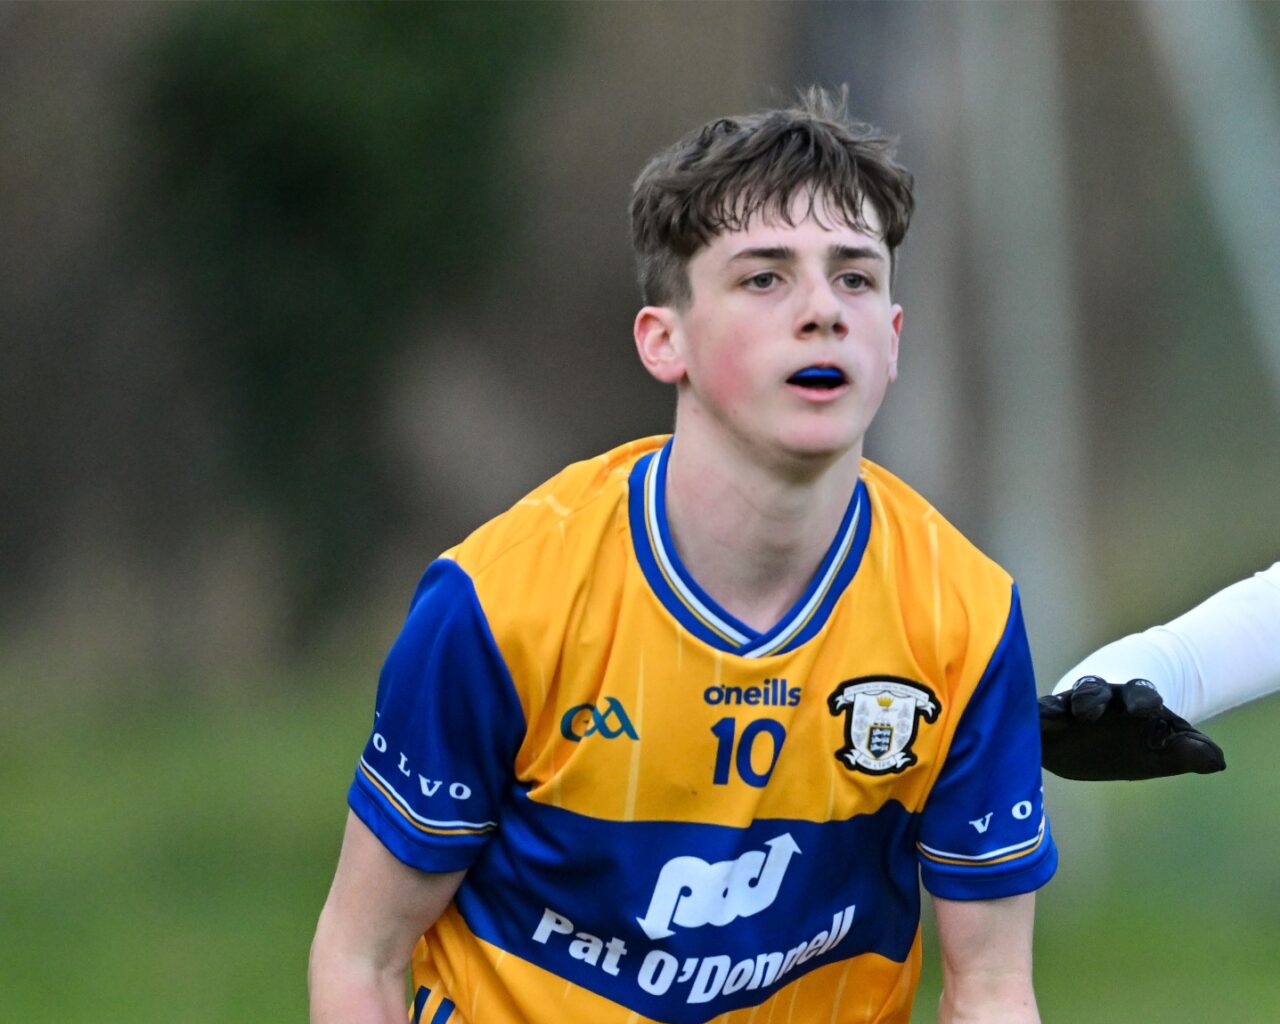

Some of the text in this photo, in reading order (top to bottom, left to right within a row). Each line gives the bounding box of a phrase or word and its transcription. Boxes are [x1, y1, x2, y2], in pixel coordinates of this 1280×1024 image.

[373, 711, 472, 801] OLVO
[710, 716, 787, 789] 10
[531, 907, 628, 977] Pat
